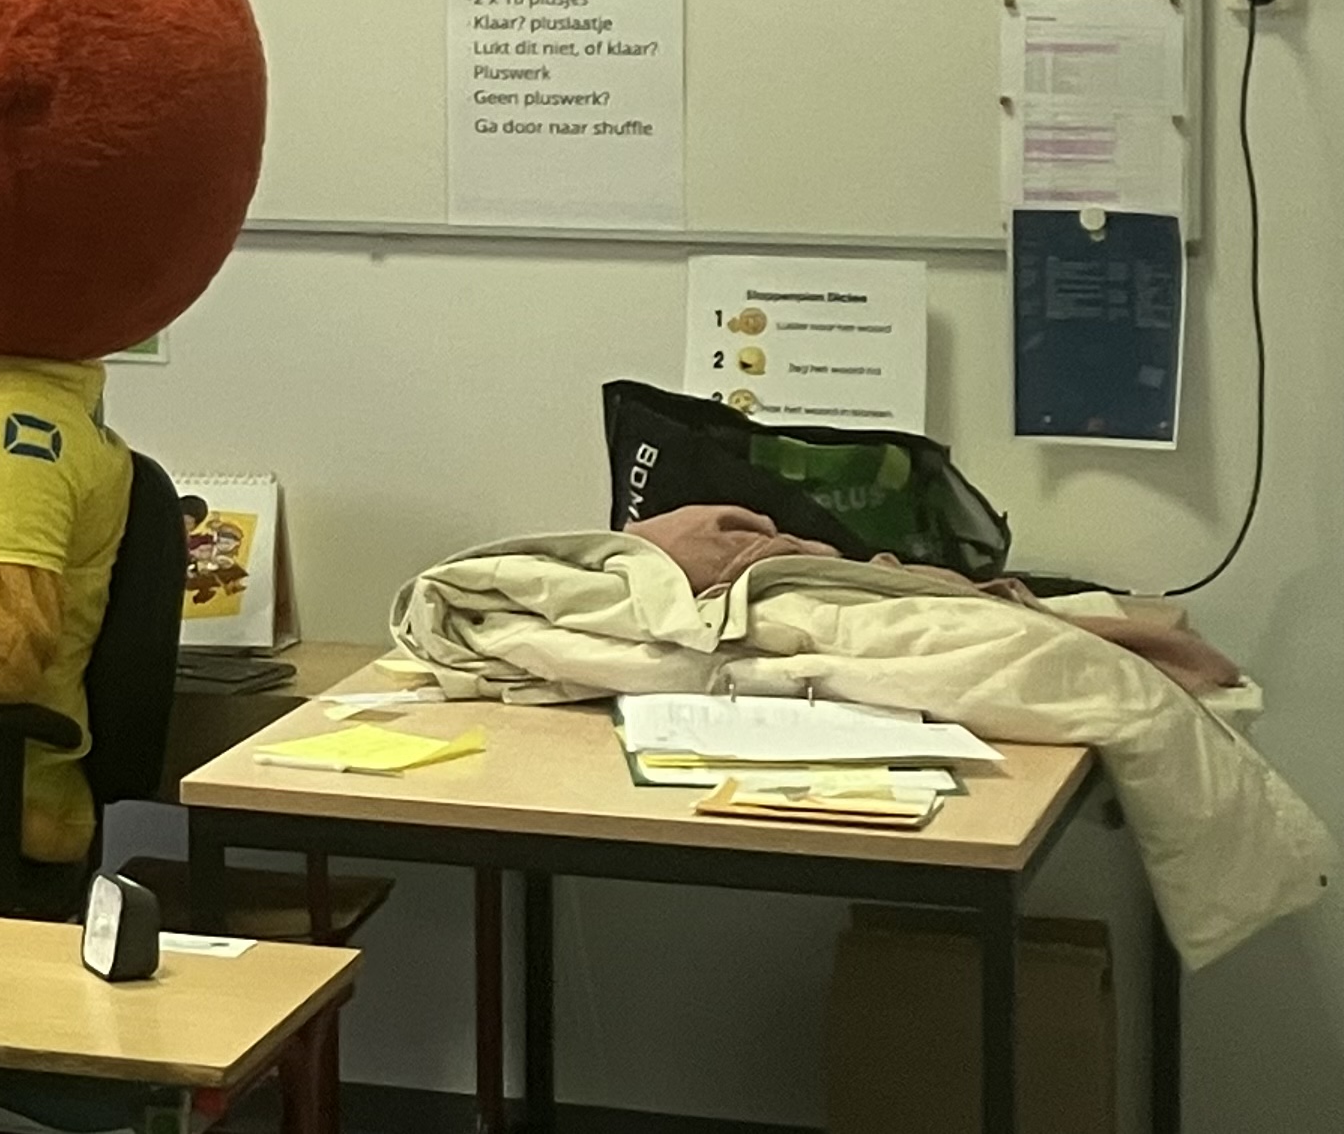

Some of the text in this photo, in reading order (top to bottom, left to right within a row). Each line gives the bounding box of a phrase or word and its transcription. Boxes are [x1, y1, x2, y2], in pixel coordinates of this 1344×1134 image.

[474, 16, 525, 30] Klaar?
[474, 40, 658, 57] Lukt dit niet, of klaar?
[474, 65, 551, 81] Pluswerk
[474, 90, 610, 109] Geen pluswerk?
[474, 119, 654, 136] Ga door naar shuffle
[715, 309, 723, 328] 1
[713, 351, 724, 368] 2
